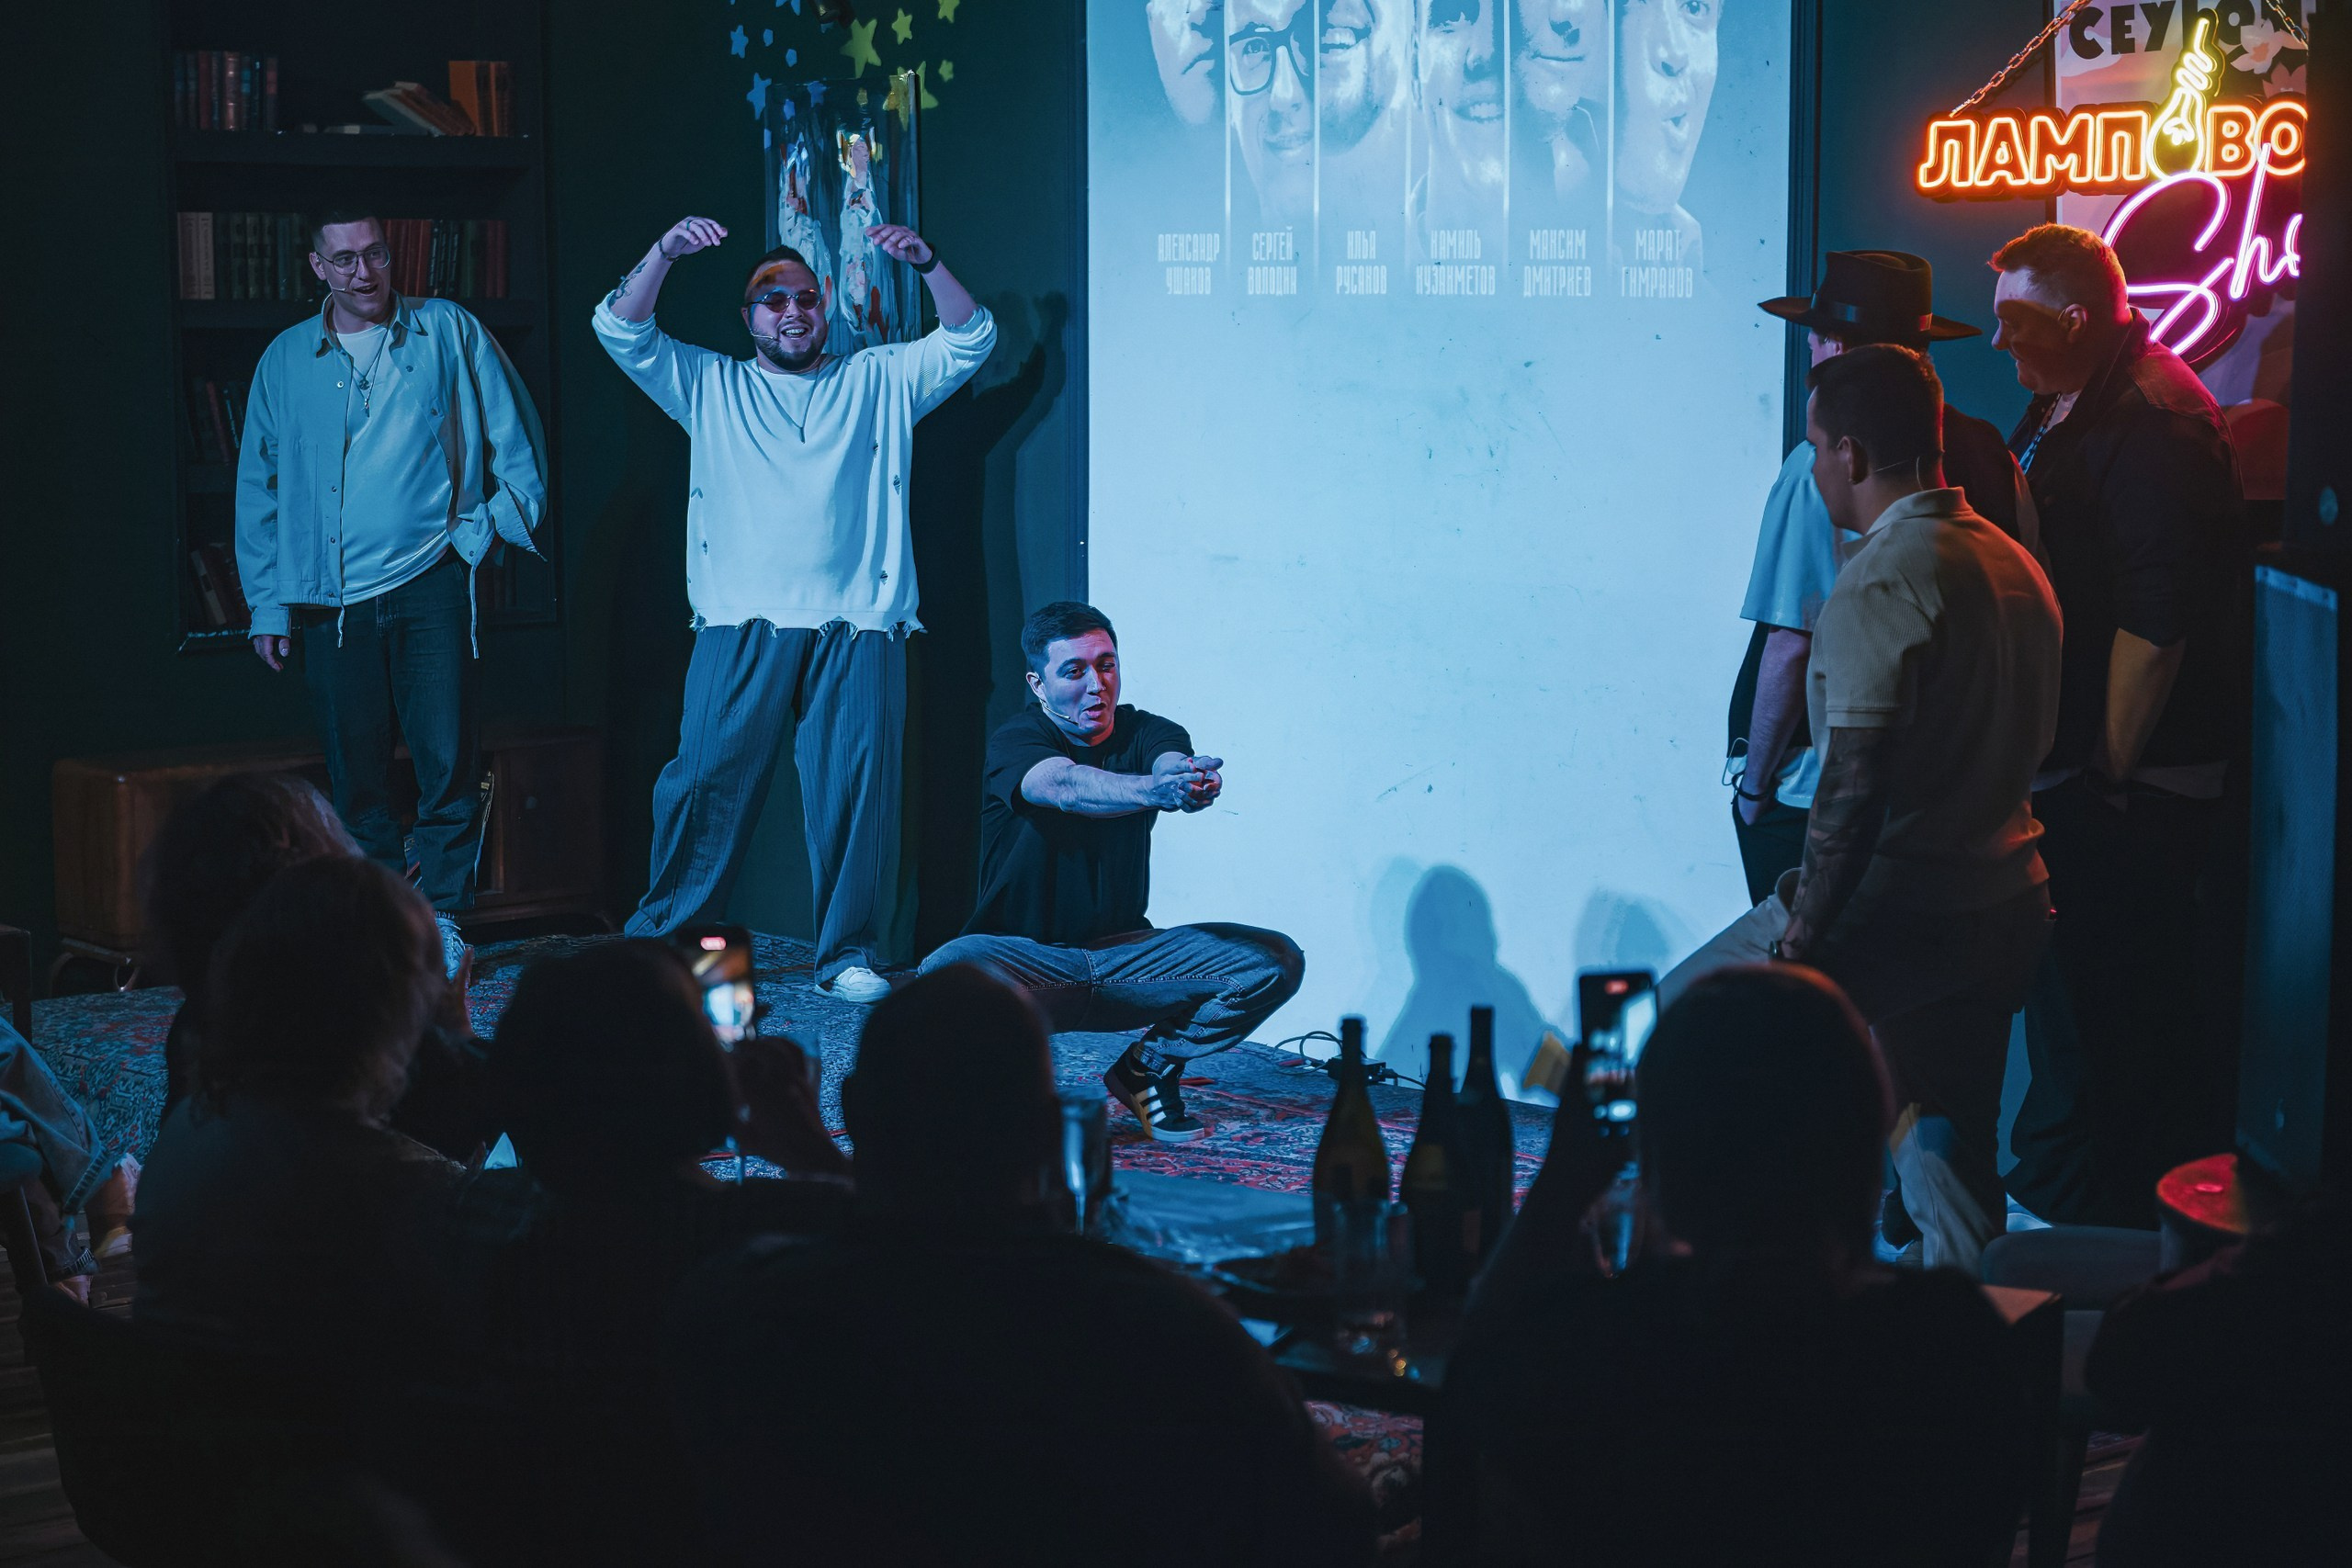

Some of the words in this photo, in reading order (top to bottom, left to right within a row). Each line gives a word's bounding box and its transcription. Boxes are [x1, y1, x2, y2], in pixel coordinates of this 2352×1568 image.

[1158, 232, 1220, 263] АЛЕКСАНДР
[1252, 225, 1294, 262] СЕРГЕЙ
[1347, 230, 1376, 260] ИЛЬЯ
[1430, 229, 1482, 260] КАМИЛЬ
[1529, 229, 1587, 260] МАКСИМ
[1635, 229, 1682, 261] МАРАТ
[1165, 265, 1212, 295] УШАКОВ
[1248, 265, 1297, 297] ВОЛОДИН
[1336, 265, 1387, 295] РУСАКОВ
[1523, 265, 1591, 298] ДМИТРИЕВ
[1621, 265, 1693, 299] ГИМРАНОВ
